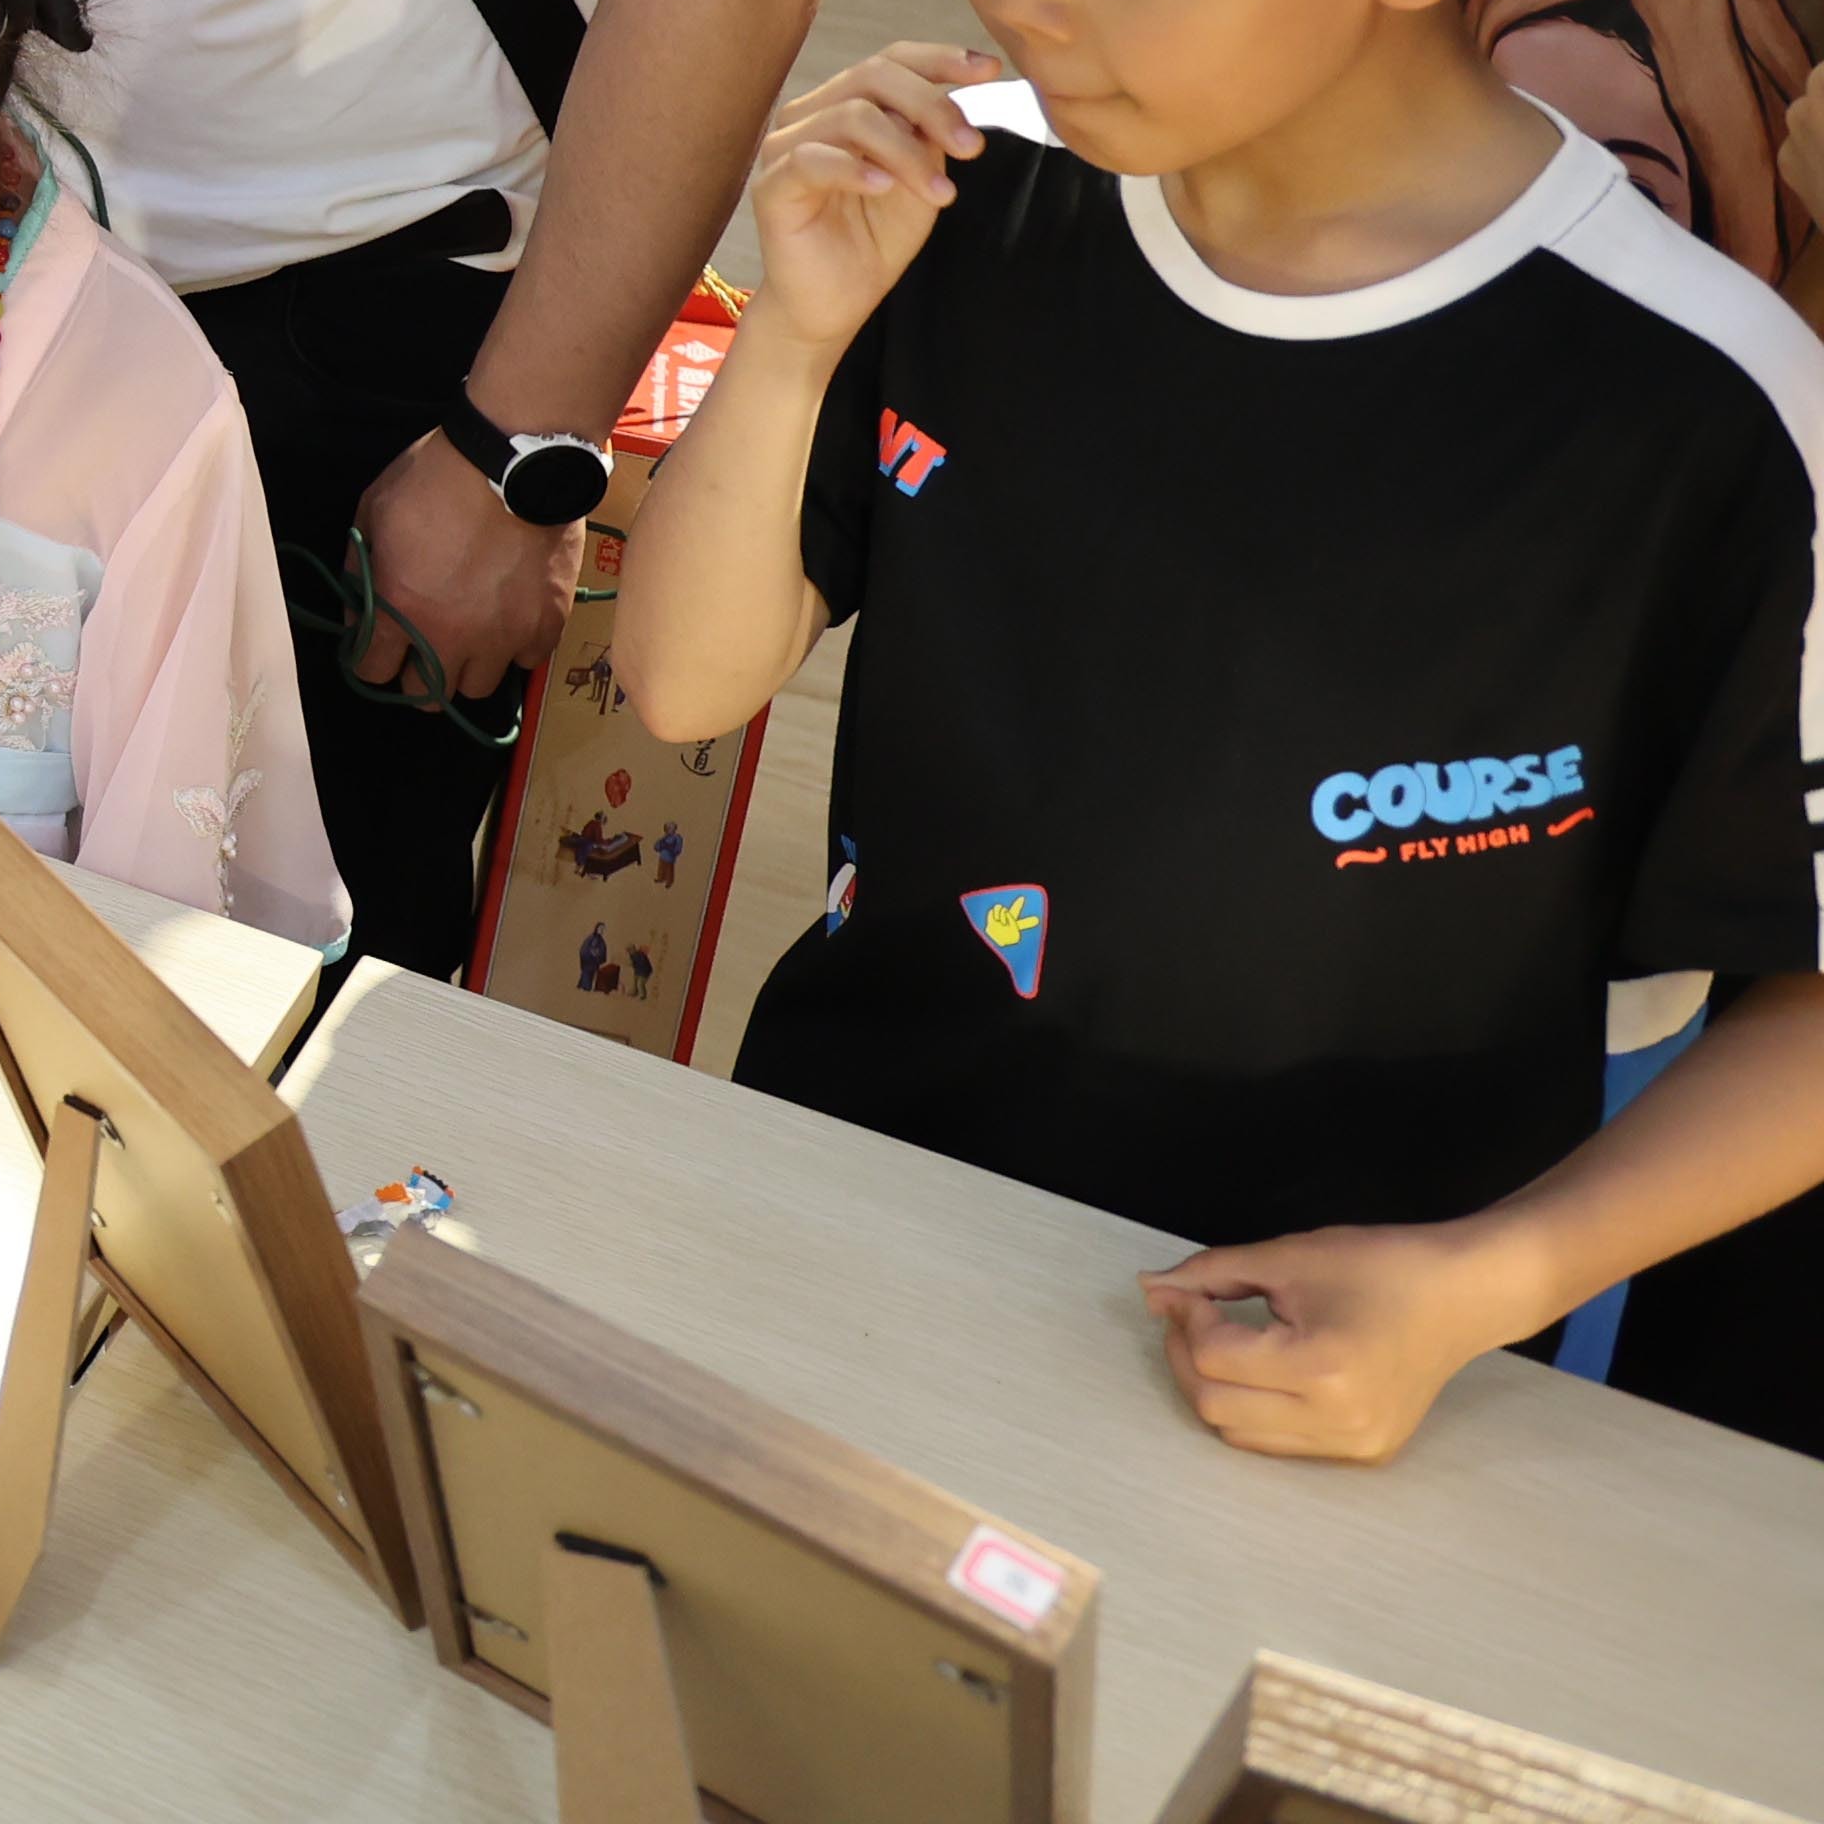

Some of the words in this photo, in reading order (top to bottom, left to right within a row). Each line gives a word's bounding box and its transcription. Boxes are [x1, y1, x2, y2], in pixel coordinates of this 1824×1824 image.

[1311, 744, 1584, 842] COURSE
[1399, 837, 1450, 863] FLY
[1455, 824, 1530, 855] HIGH
